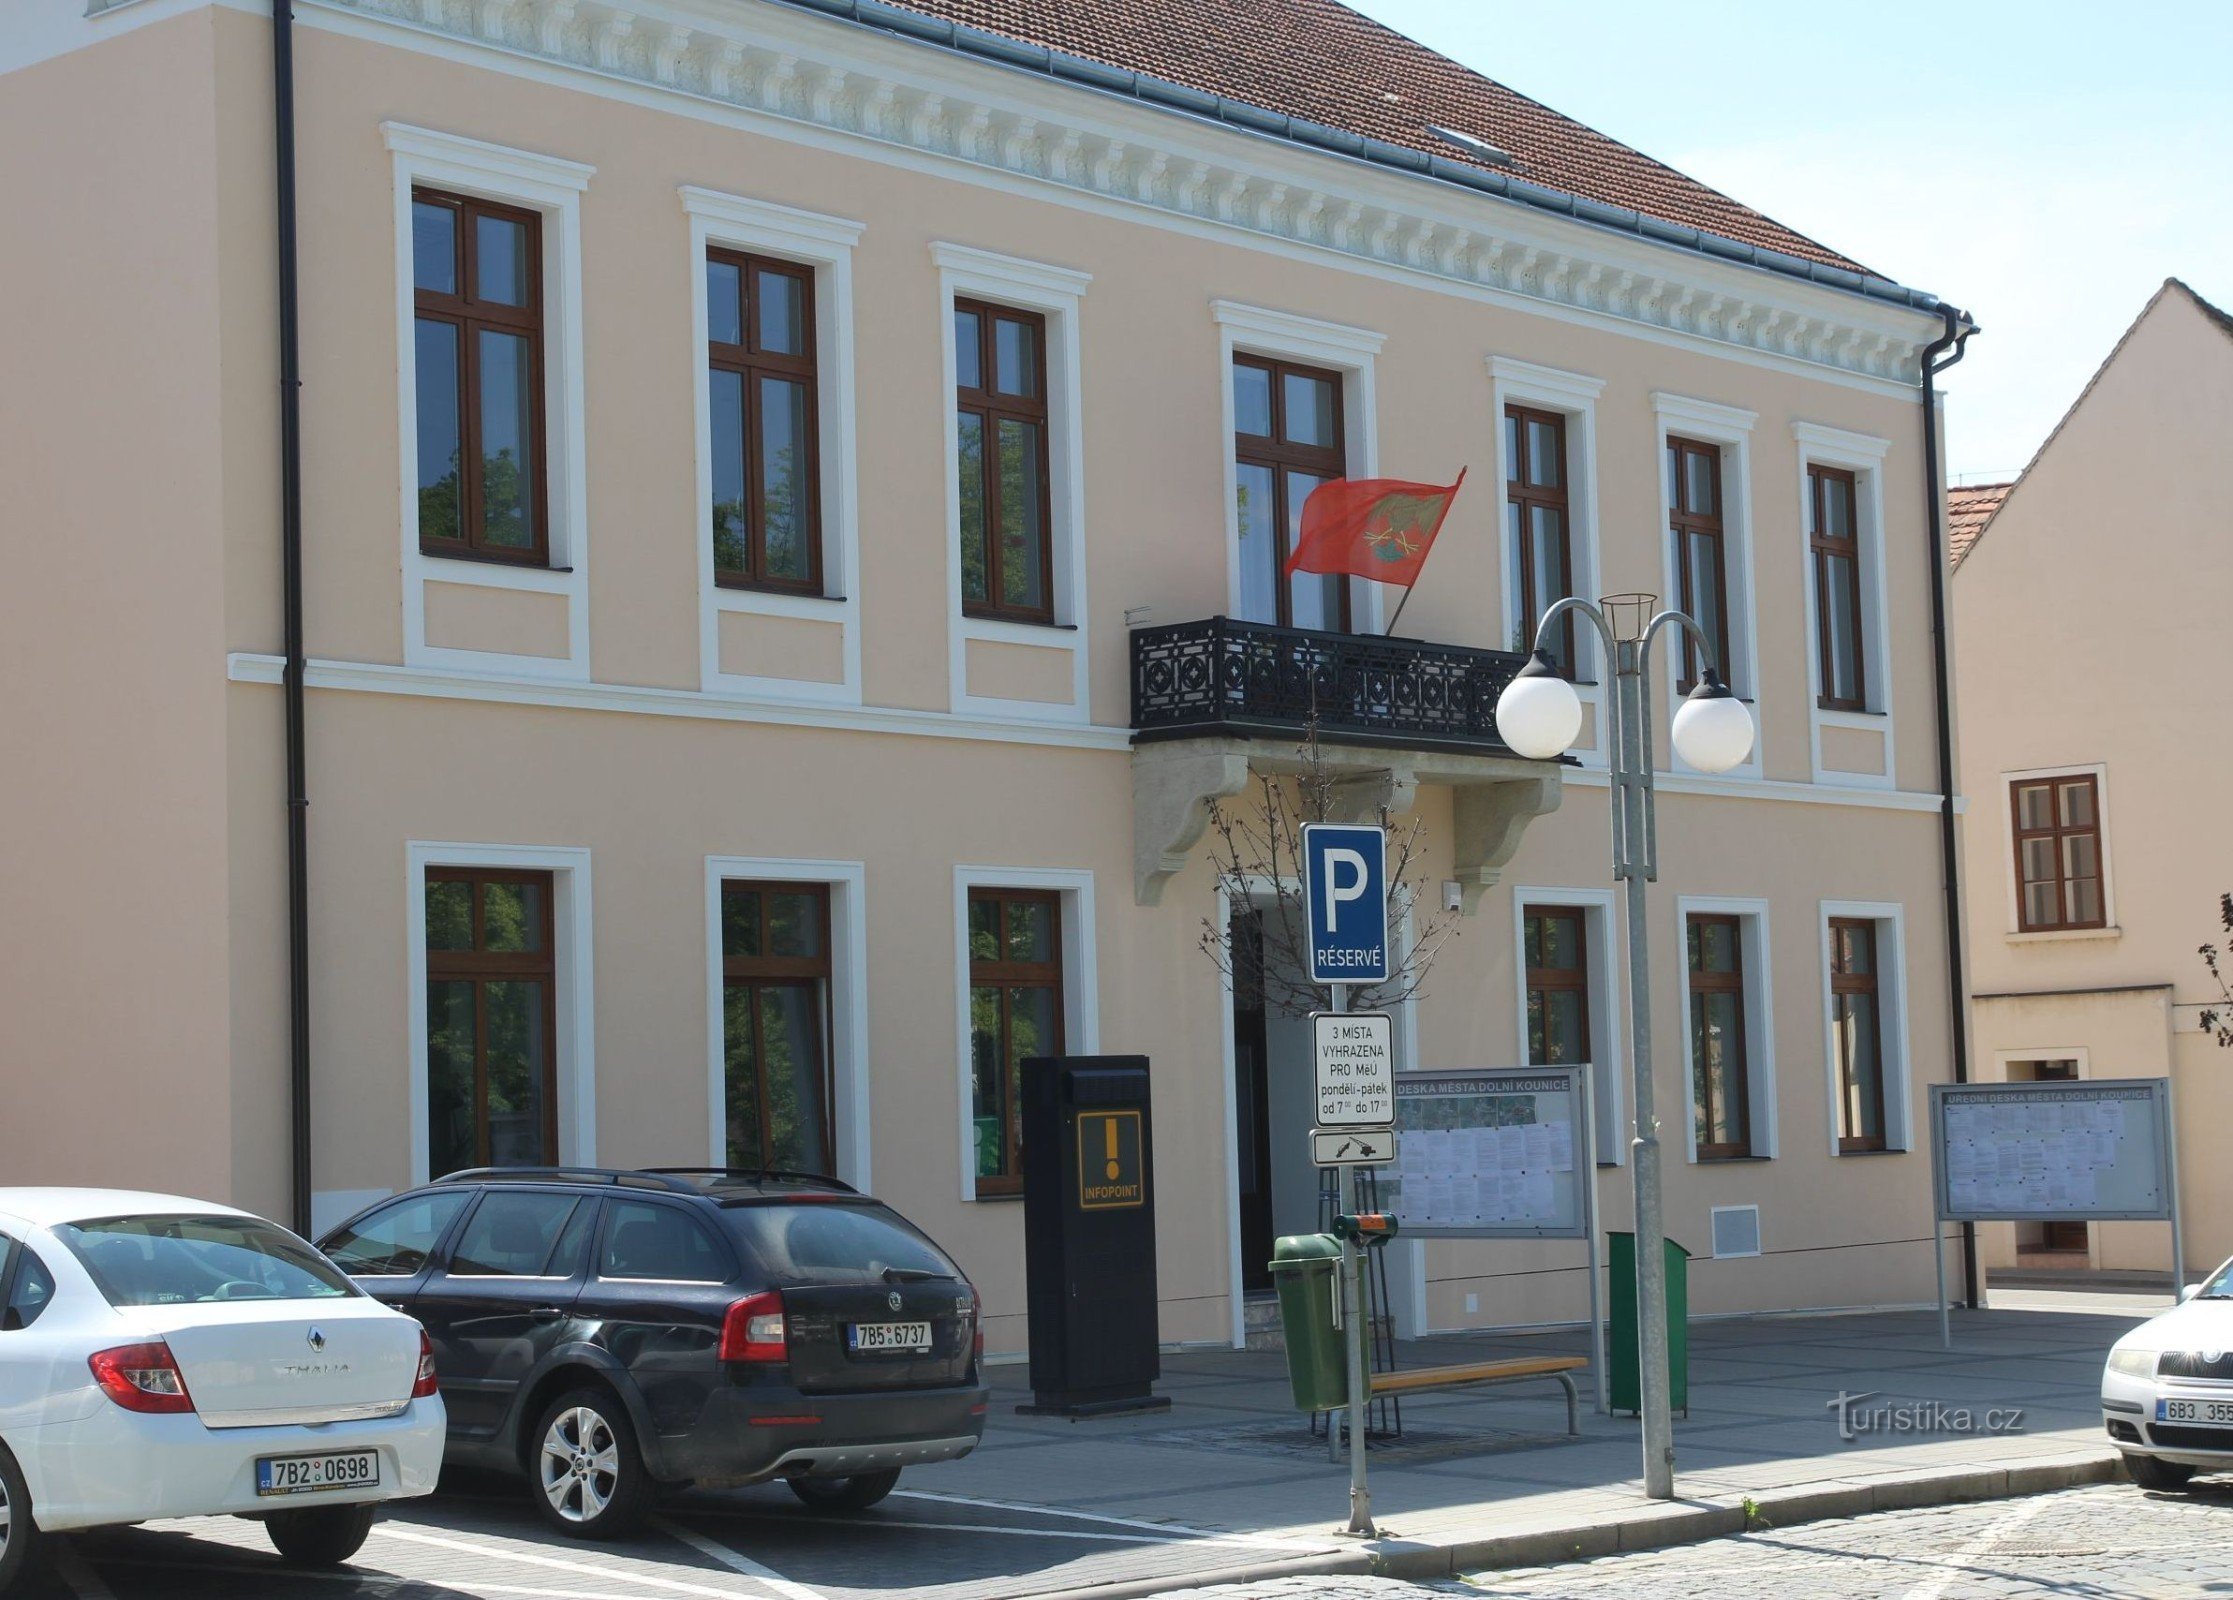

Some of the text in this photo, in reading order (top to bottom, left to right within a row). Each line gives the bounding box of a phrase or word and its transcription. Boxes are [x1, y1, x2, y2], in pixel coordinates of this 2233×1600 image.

[1324, 848, 1368, 933] P
[1318, 945, 1381, 967] RÉSERVÉ
[1333, 1024, 1373, 1039] 3 MÍSTA
[1322, 1045, 1384, 1058] VYHRAZENA
[1330, 1060, 1377, 1076] PRO MěÚ
[1397, 1084, 1436, 1095] DESKA
[1516, 1079, 1569, 1091] KOUNICE
[1323, 1102, 1335, 1114] od
[1355, 1101, 1367, 1113] do
[1085, 1184, 1138, 1199] INFOPOINT
[859, 1325, 925, 1346] 7B5 6737
[285, 1364, 351, 1375] THALIA
[2169, 1403, 2196, 1419] 6B3
[275, 1457, 369, 1486] 7B2 0698
[261, 1480, 271, 1488] CZ
